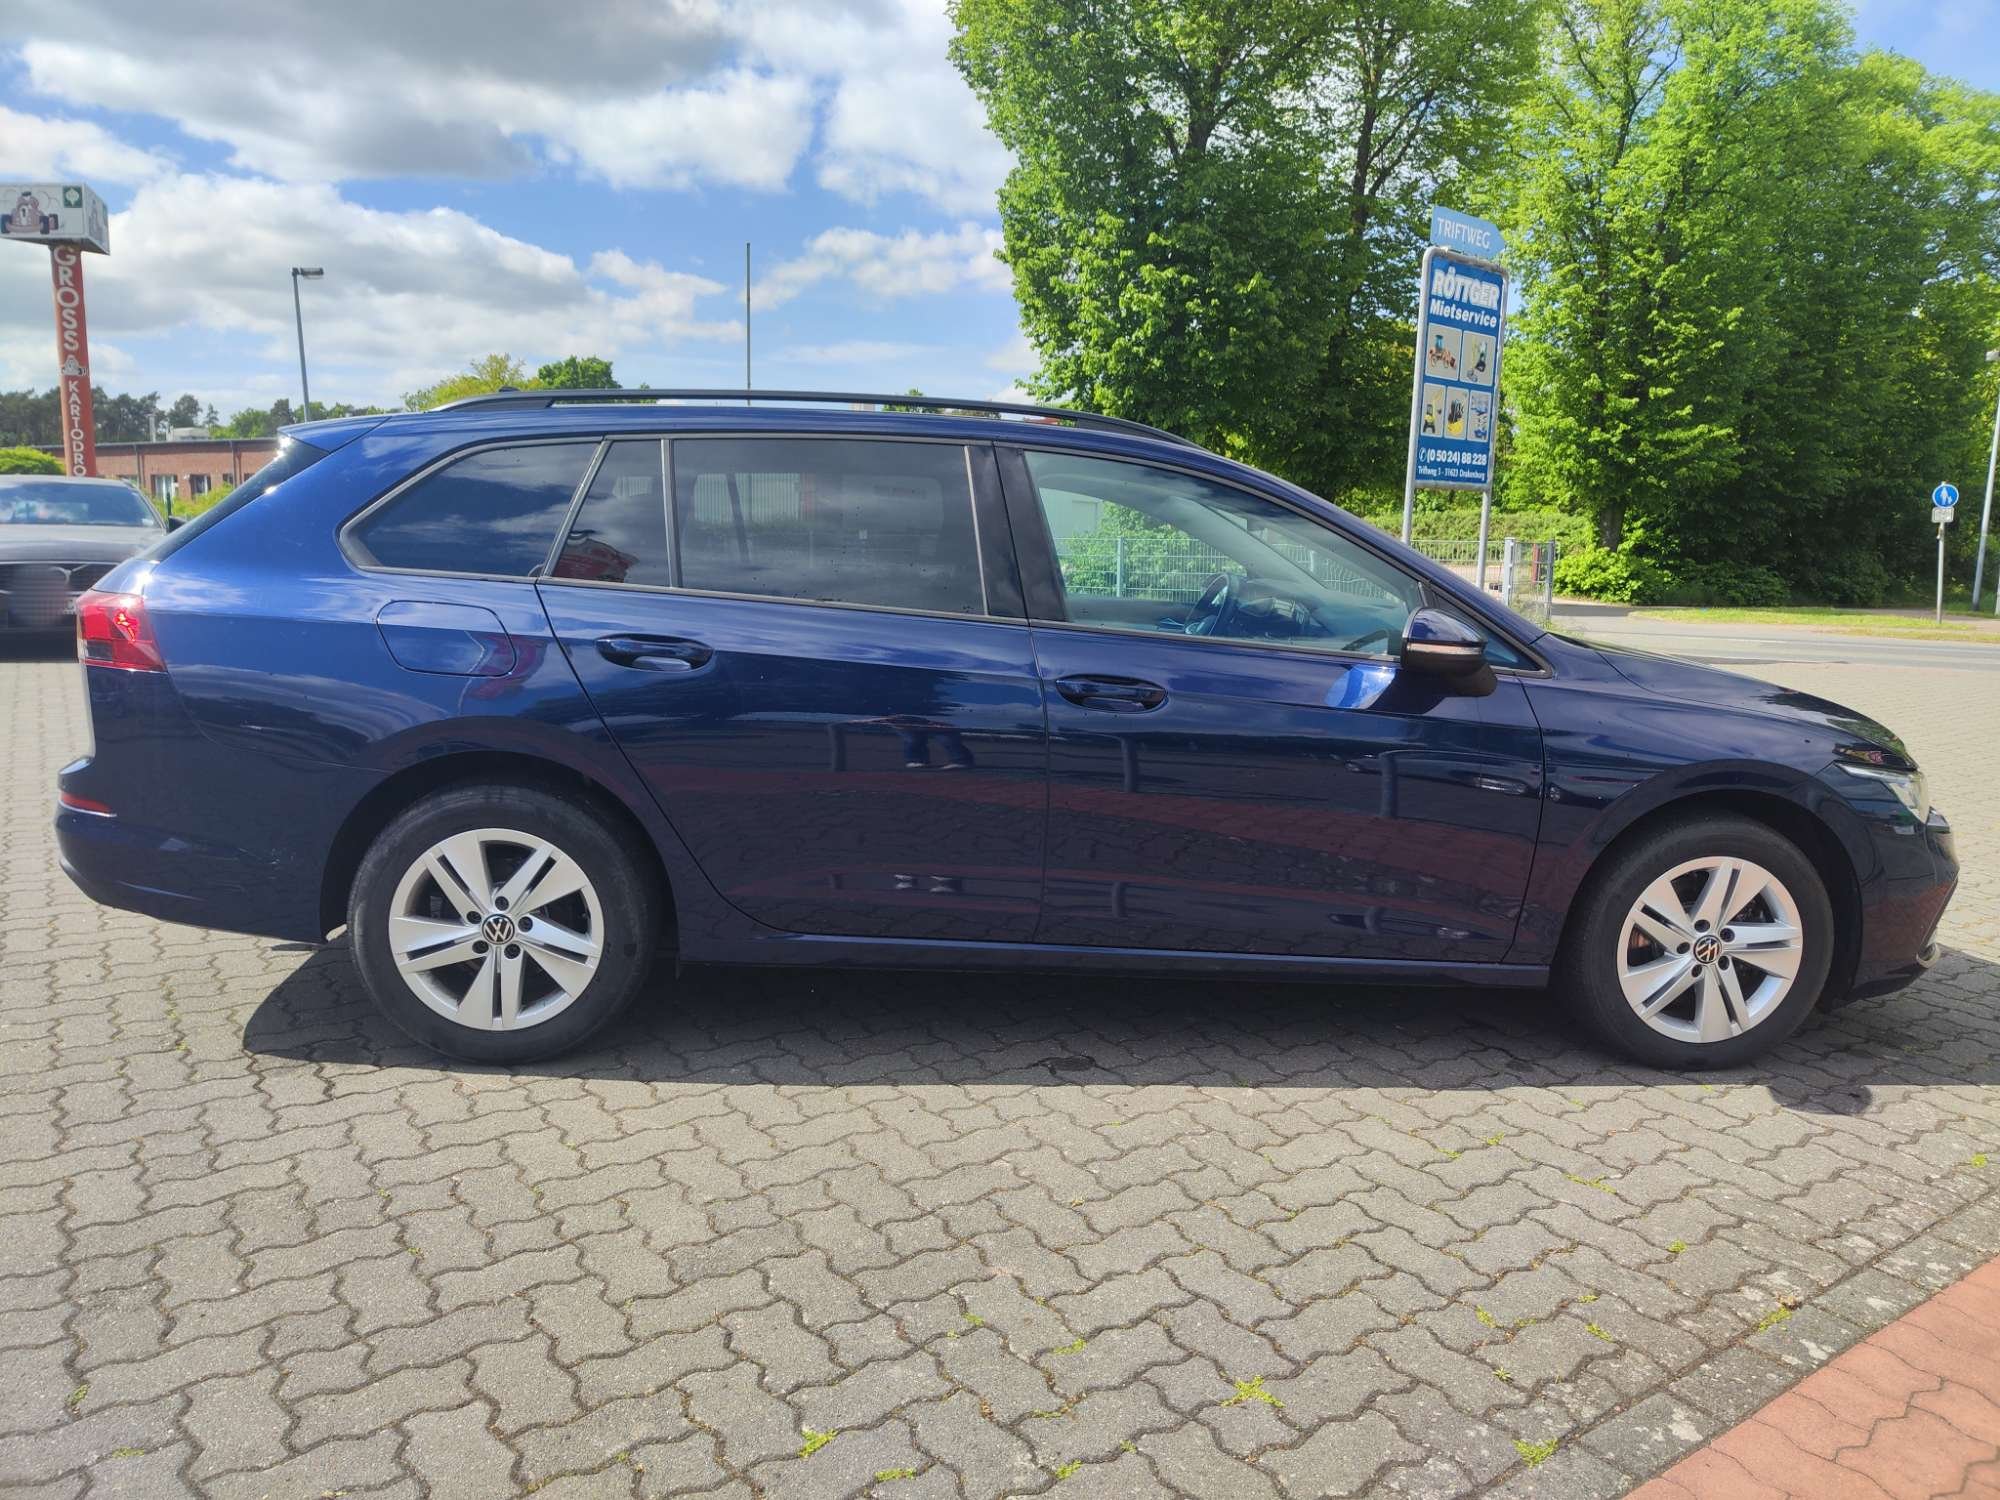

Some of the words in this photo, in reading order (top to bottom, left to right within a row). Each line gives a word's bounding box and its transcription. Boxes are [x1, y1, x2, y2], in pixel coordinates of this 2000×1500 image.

[1437, 217, 1491, 249] TRIFTWEG
[54, 244, 80, 351] GROSS
[1431, 266, 1500, 310] RÖTTGER
[1430, 298, 1497, 328] Mietservice
